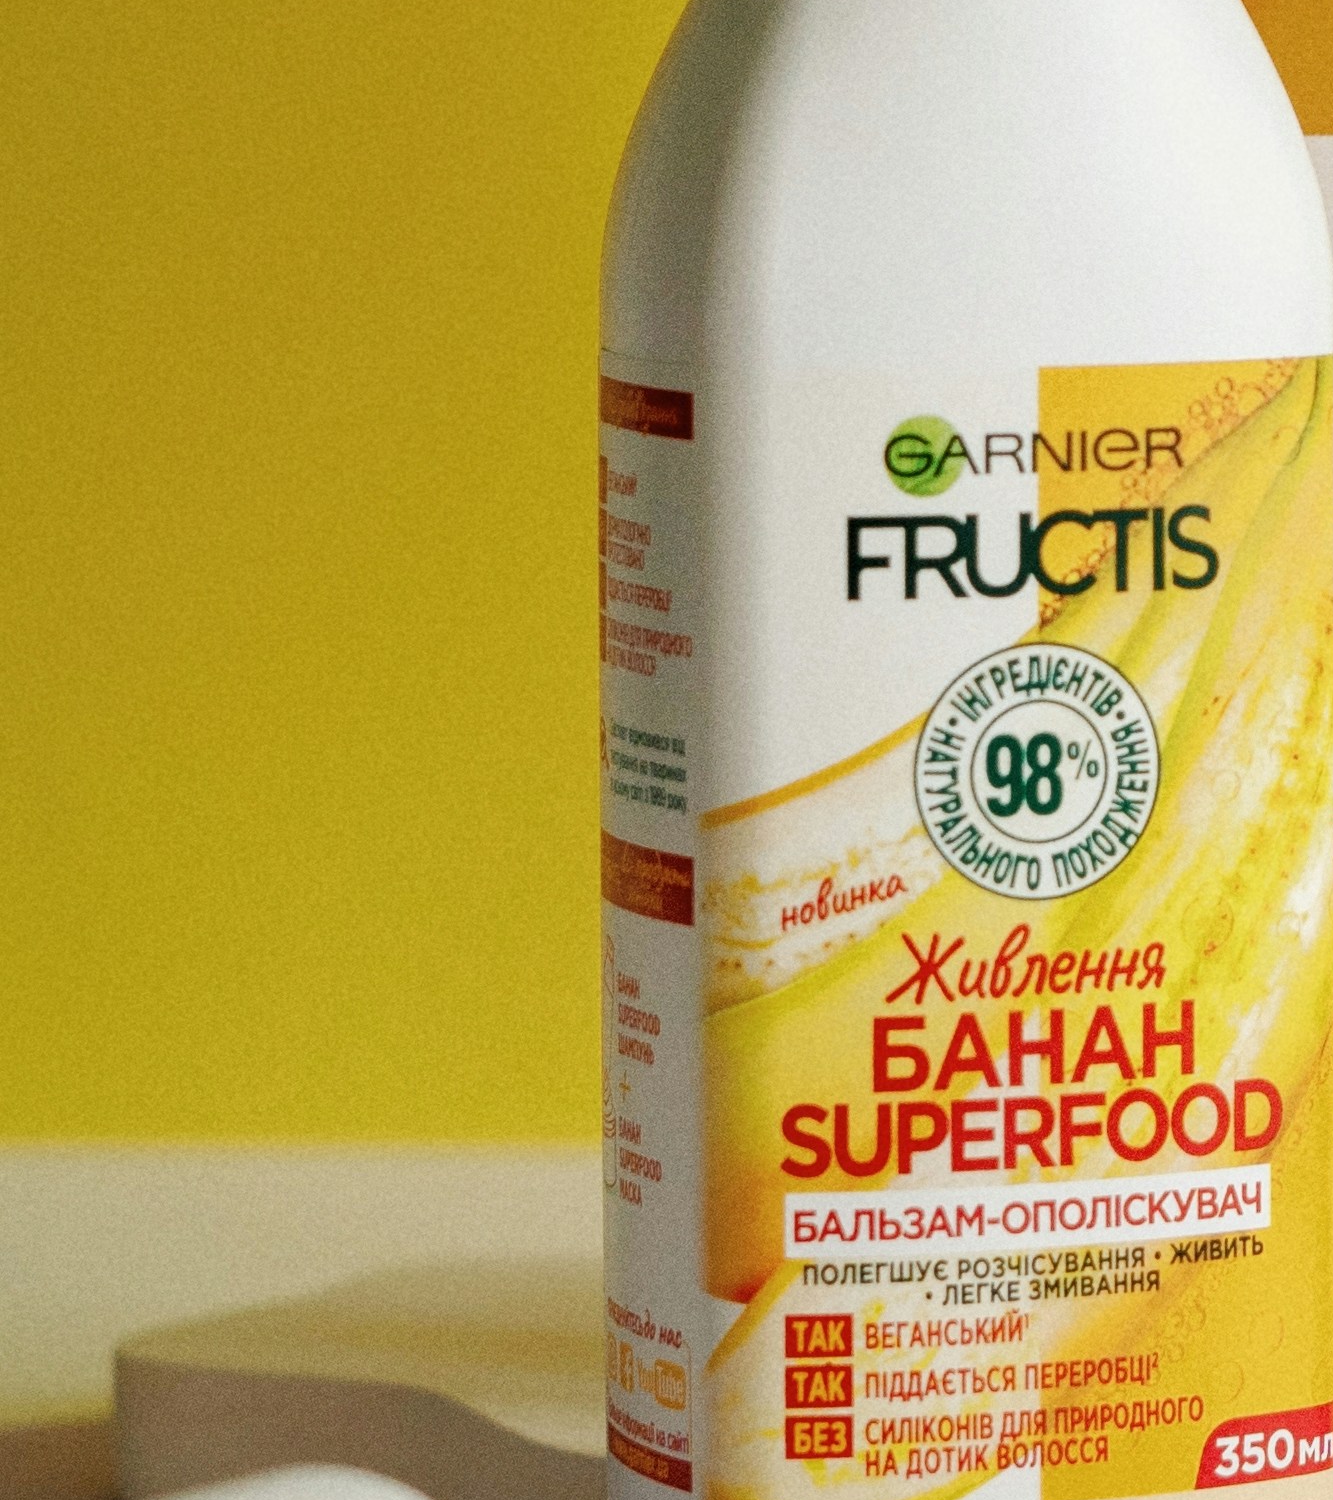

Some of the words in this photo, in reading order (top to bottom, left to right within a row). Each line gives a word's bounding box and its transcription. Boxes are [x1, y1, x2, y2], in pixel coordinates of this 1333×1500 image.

[883, 425, 1184, 478] GARNIER
[846, 504, 1219, 600] FRUCTIS
[951, 654, 1124, 722] ІНГРЕДІЄНТІВ
[925, 726, 1041, 890] НАТУРАЛЬНОГО
[1052, 719, 1150, 888] ПОХОДЖЕННЯ
[986, 732, 1099, 818] 98%
[781, 872, 908, 933] новинка
[885, 923, 1167, 1005] Живлення
[872, 999, 1195, 1093] БАНАН
[779, 1078, 1284, 1179] SUPERFOOD
[792, 1182, 1263, 1244] БАЛЬЗАМ-ОПОЛІСКУВАЧ
[802, 1259, 949, 1287] ПОЛЕГШУЄ
[957, 1248, 1145, 1279] РОЗЧІСУВАННЯ
[1169, 1236, 1265, 1265] ЖИВИТЬ
[942, 1280, 1021, 1307] ЛЕГКЕ
[1027, 1270, 1161, 1301] ЗМИВАННЯ
[792, 1320, 847, 1354] ТАК
[792, 1369, 847, 1403] ТАК
[865, 1365, 1016, 1402] ПІДДАЄТЬСЯ
[793, 1420, 848, 1454] БЕЗ
[865, 1411, 994, 1444] СИЛІКОНІВ
[1000, 1409, 1048, 1440] ДЛЯ
[1054, 1395, 1204, 1436] ПРИРОДНОГО
[865, 1452, 899, 1477] НА
[906, 1447, 988, 1479] ДОТИК
[996, 1435, 1109, 1472] ВОЛОССЯ
